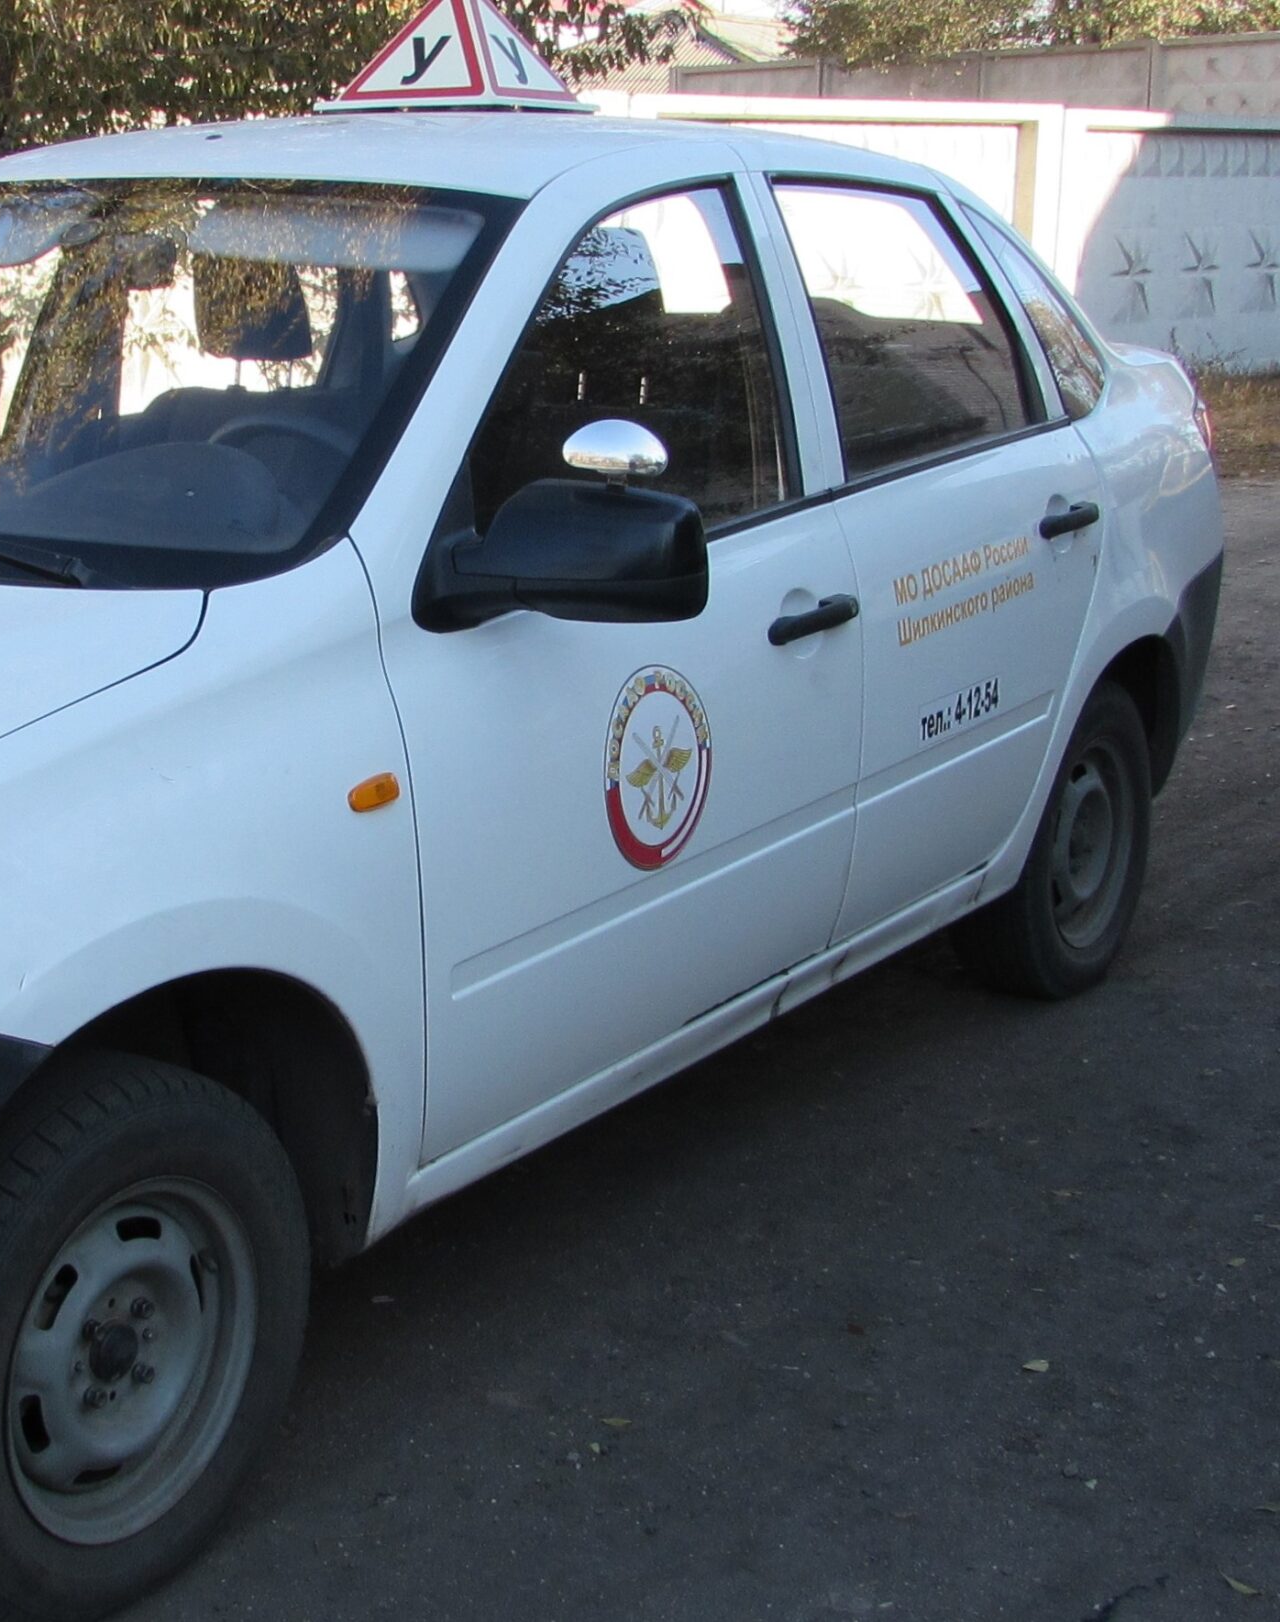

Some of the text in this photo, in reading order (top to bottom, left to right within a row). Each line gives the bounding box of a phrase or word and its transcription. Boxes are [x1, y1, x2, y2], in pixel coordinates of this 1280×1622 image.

[400, 36, 452, 86] У
[893, 536, 1029, 606] МО ДОСААФ России
[897, 571, 1035, 647] Шилкинского района
[921, 677, 999, 741] тел.: 4-12-54
